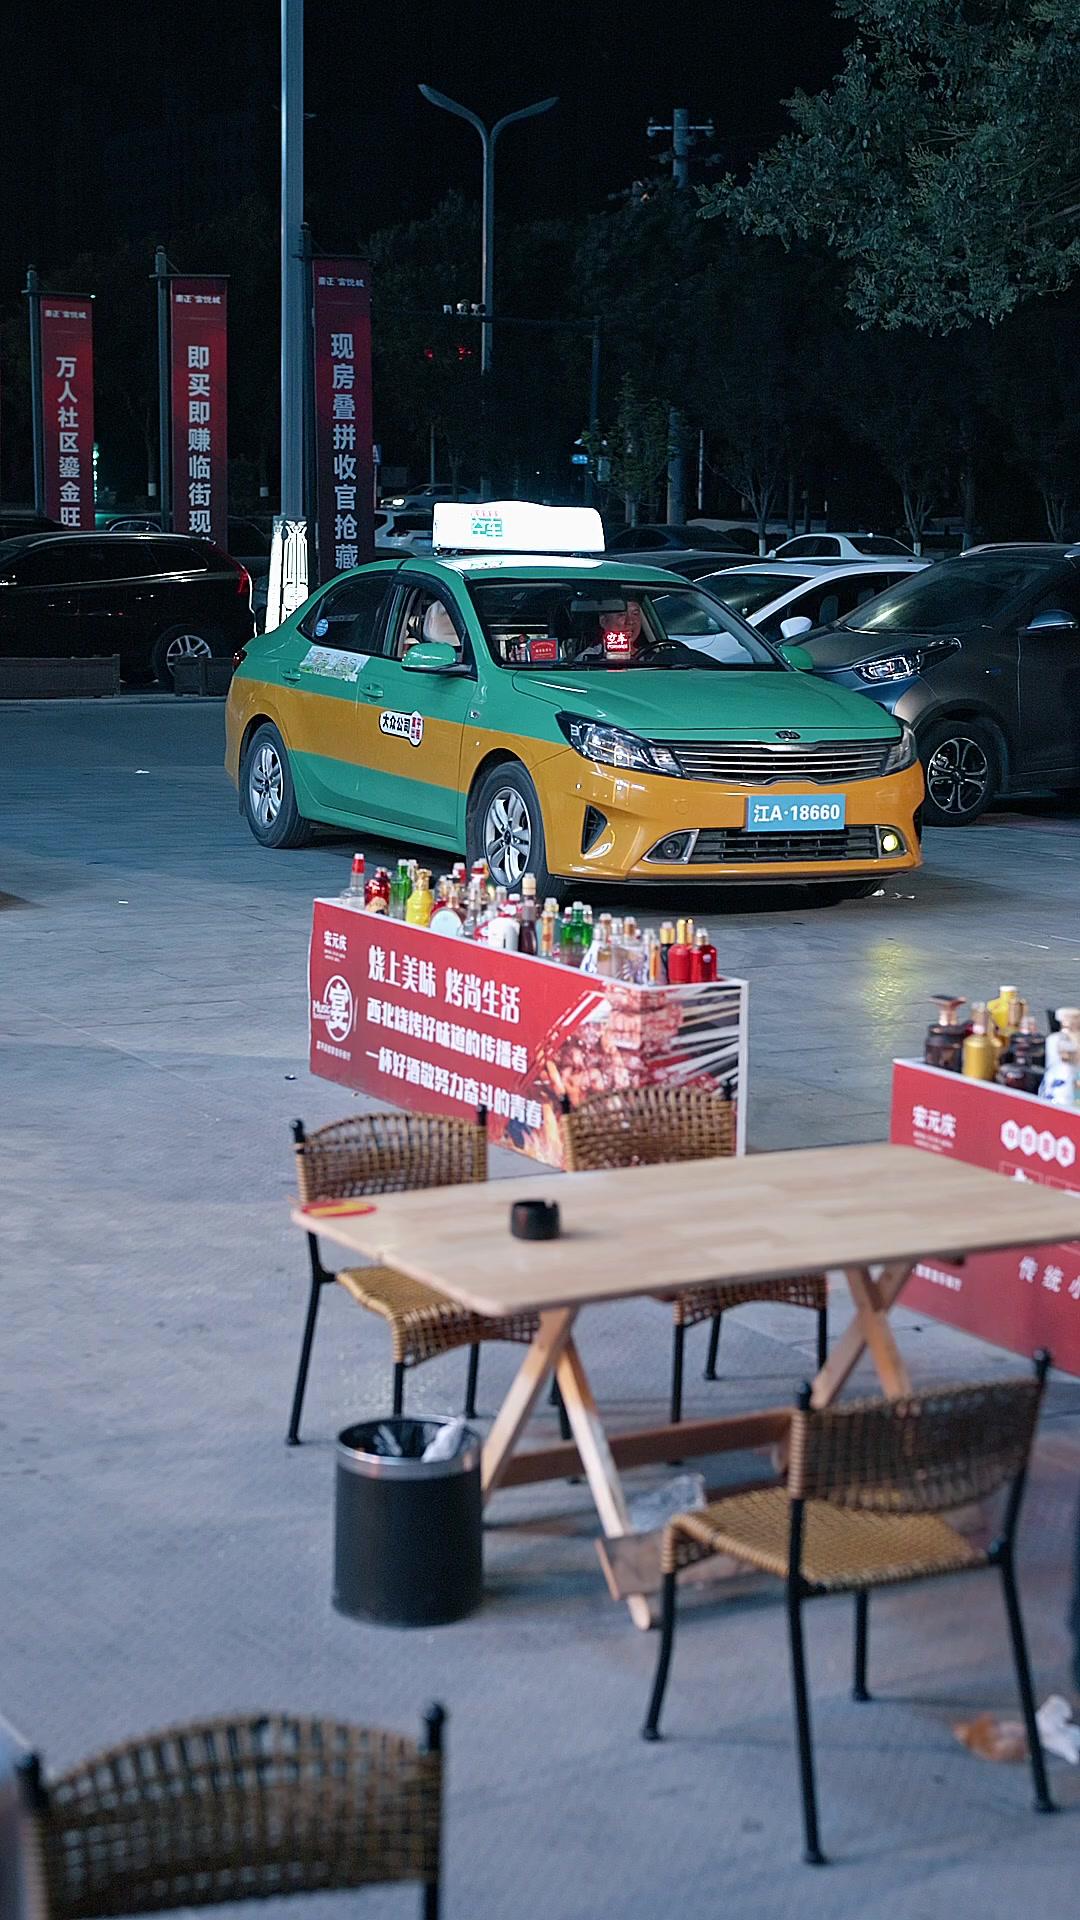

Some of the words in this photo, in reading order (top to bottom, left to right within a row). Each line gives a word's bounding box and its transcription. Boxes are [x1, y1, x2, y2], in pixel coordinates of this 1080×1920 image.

[56, 356, 81, 527] 万人社区鎏金旺
[187, 345, 211, 541] 即买即赚临街现
[330, 333, 358, 570] 现房叠拼收官抢藏
[606, 632, 628, 644] 空车
[382, 713, 411, 734] 大众公司
[328, 982, 349, 1032] 宴
[367, 944, 437, 997] 烧上美味
[445, 967, 521, 1024] 烤尚生活
[366, 997, 528, 1074] 西北烧烤好味道的传播者
[365, 1046, 543, 1129] 一杯好酒敬努力奋斗的青春
[912, 1104, 956, 1138] 宏元庆
